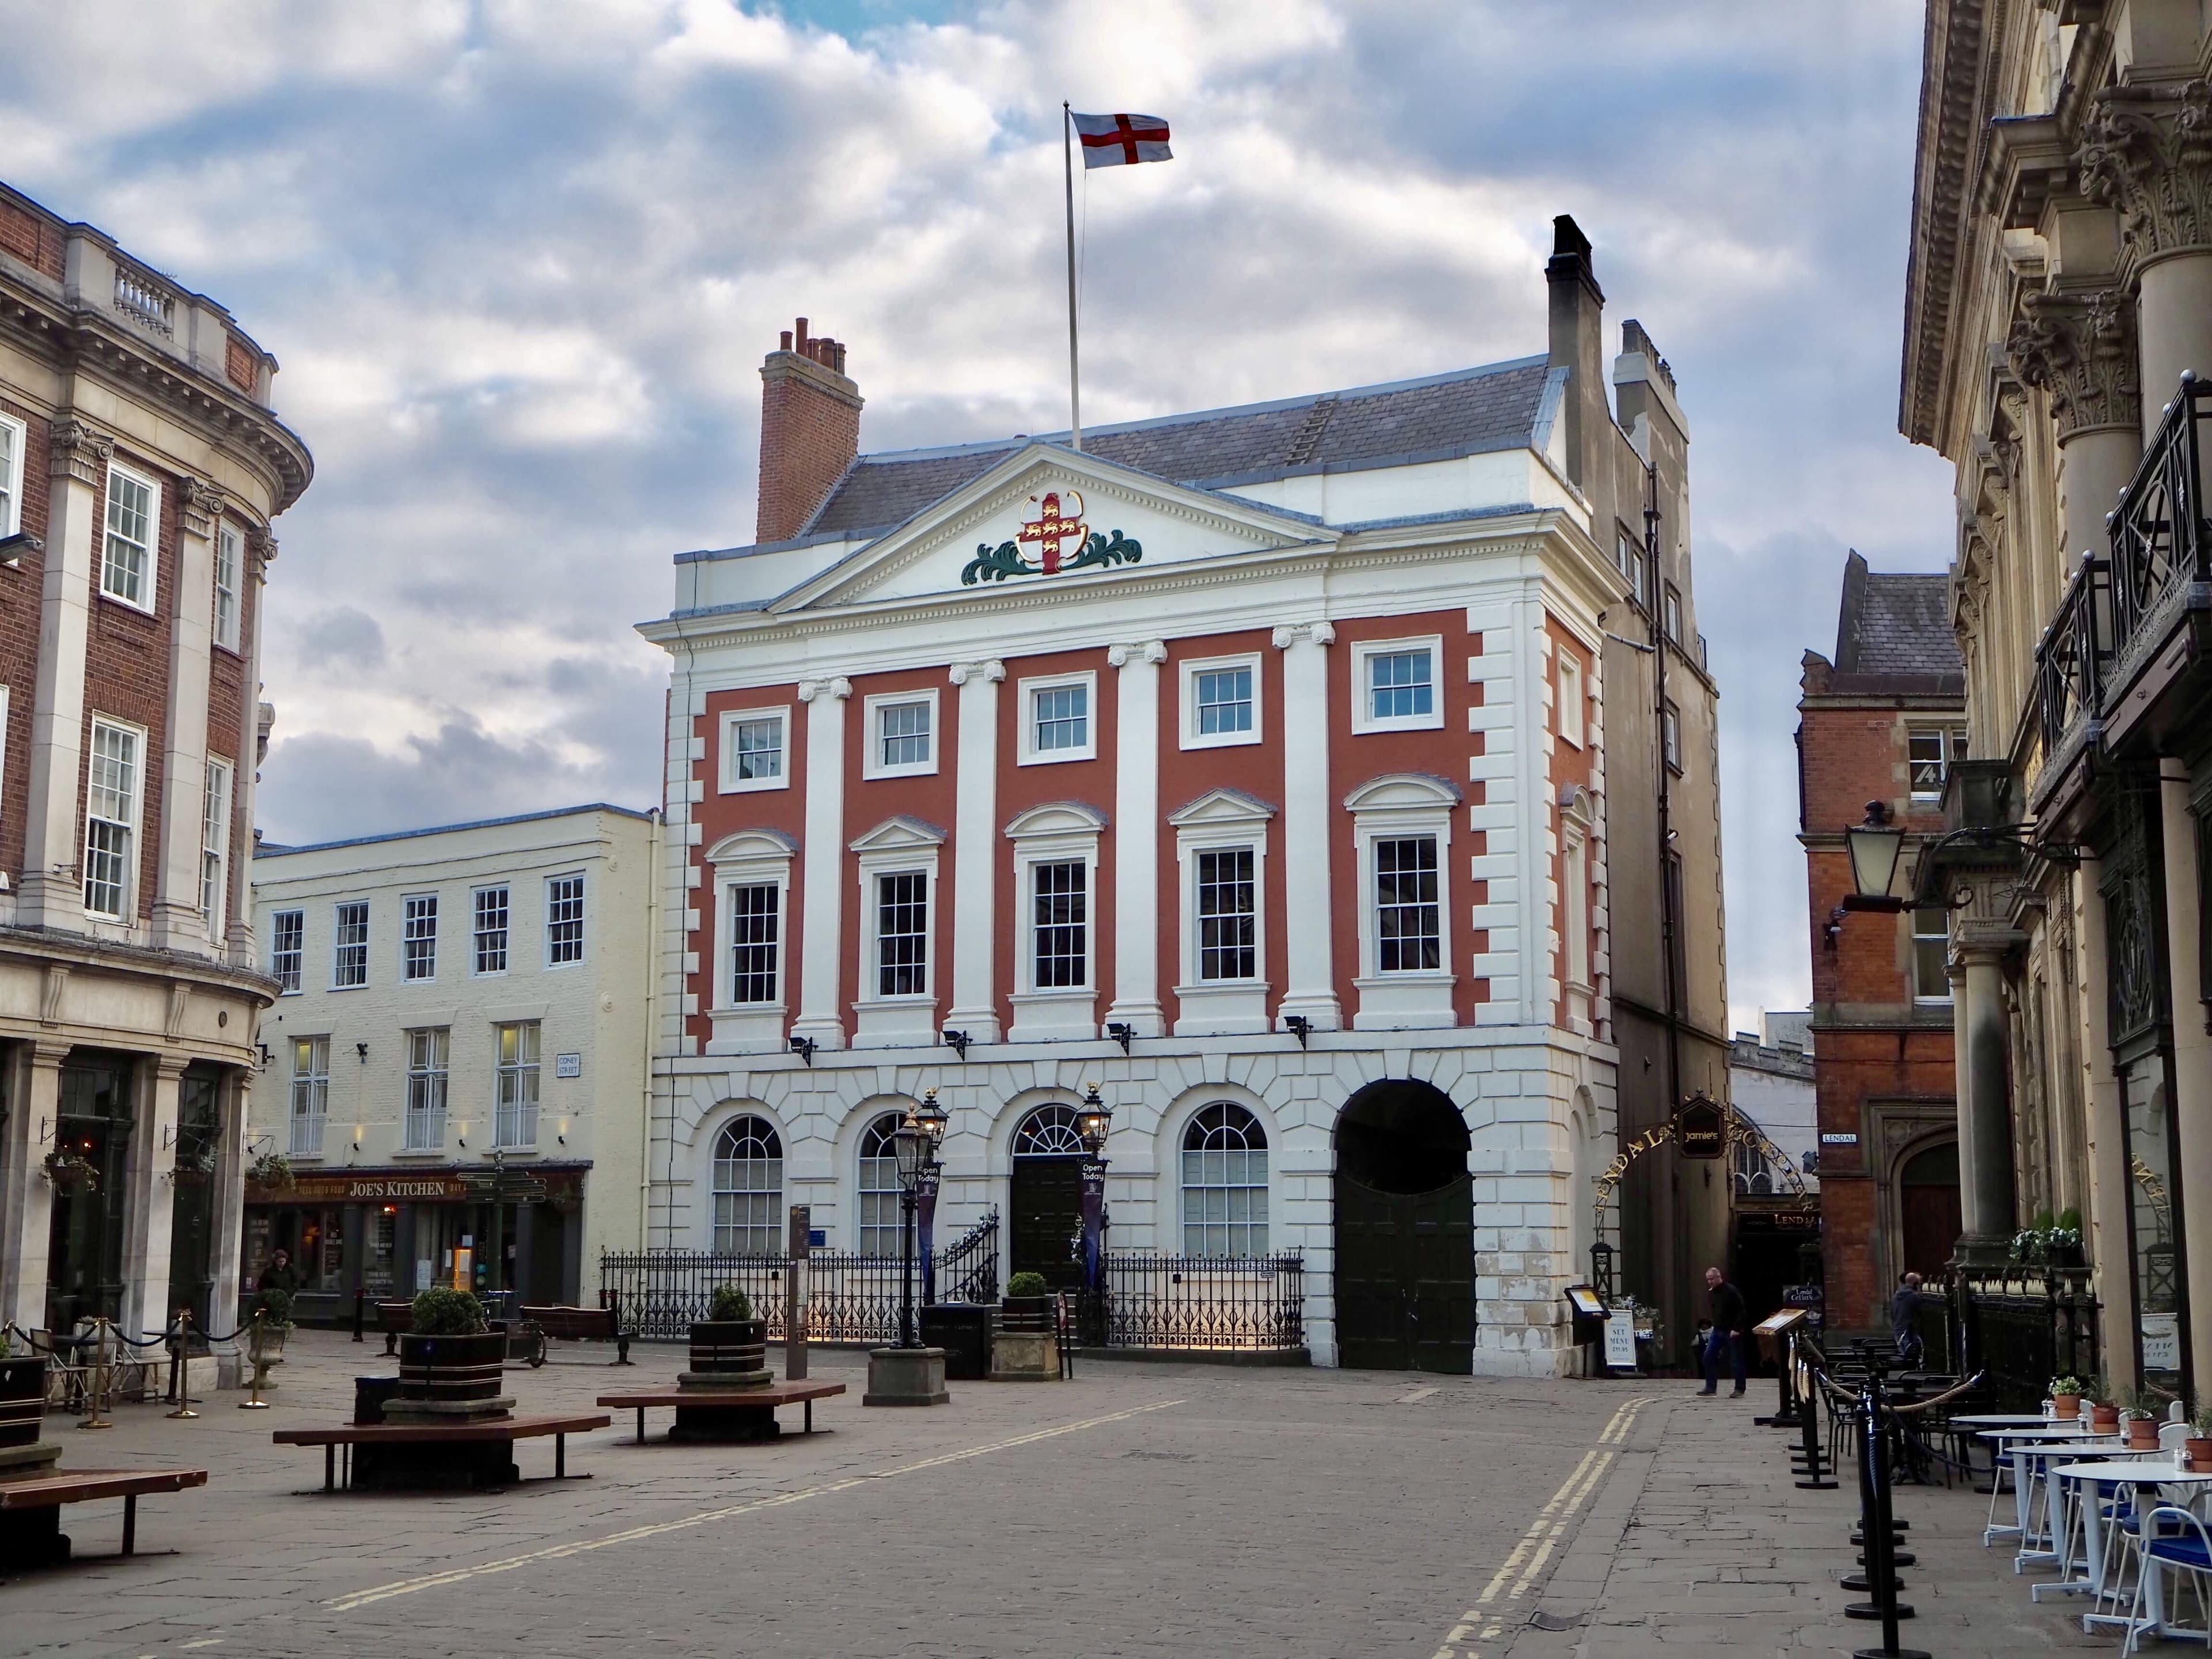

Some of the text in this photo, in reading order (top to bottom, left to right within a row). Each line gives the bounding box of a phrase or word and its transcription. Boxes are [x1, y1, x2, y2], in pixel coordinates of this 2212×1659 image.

[1083, 1164, 1103, 1173] Open
[918, 1175, 939, 1184] Today
[1082, 1172, 1104, 1181] Today
[350, 1183, 384, 1197] JOE'S
[386, 1181, 445, 1196] KITCHEN
[450, 1184, 461, 1192] DAY
